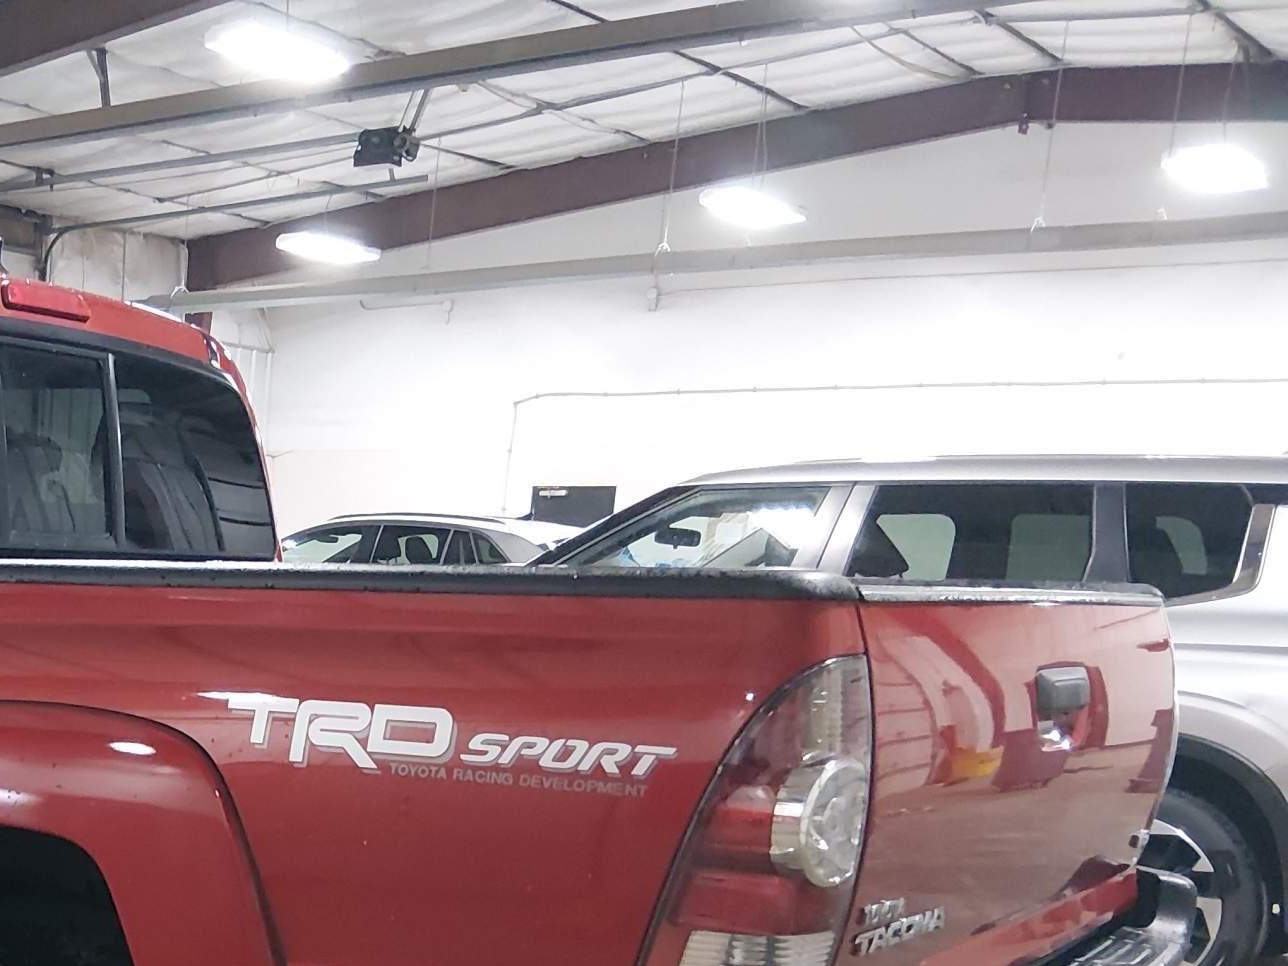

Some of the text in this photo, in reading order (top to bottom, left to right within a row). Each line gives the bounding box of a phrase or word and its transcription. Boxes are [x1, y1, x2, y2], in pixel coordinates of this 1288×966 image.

[197, 692, 678, 779] TRD SPORT
[389, 762, 649, 797] TOYOTA RACING DEVELOPMENT
